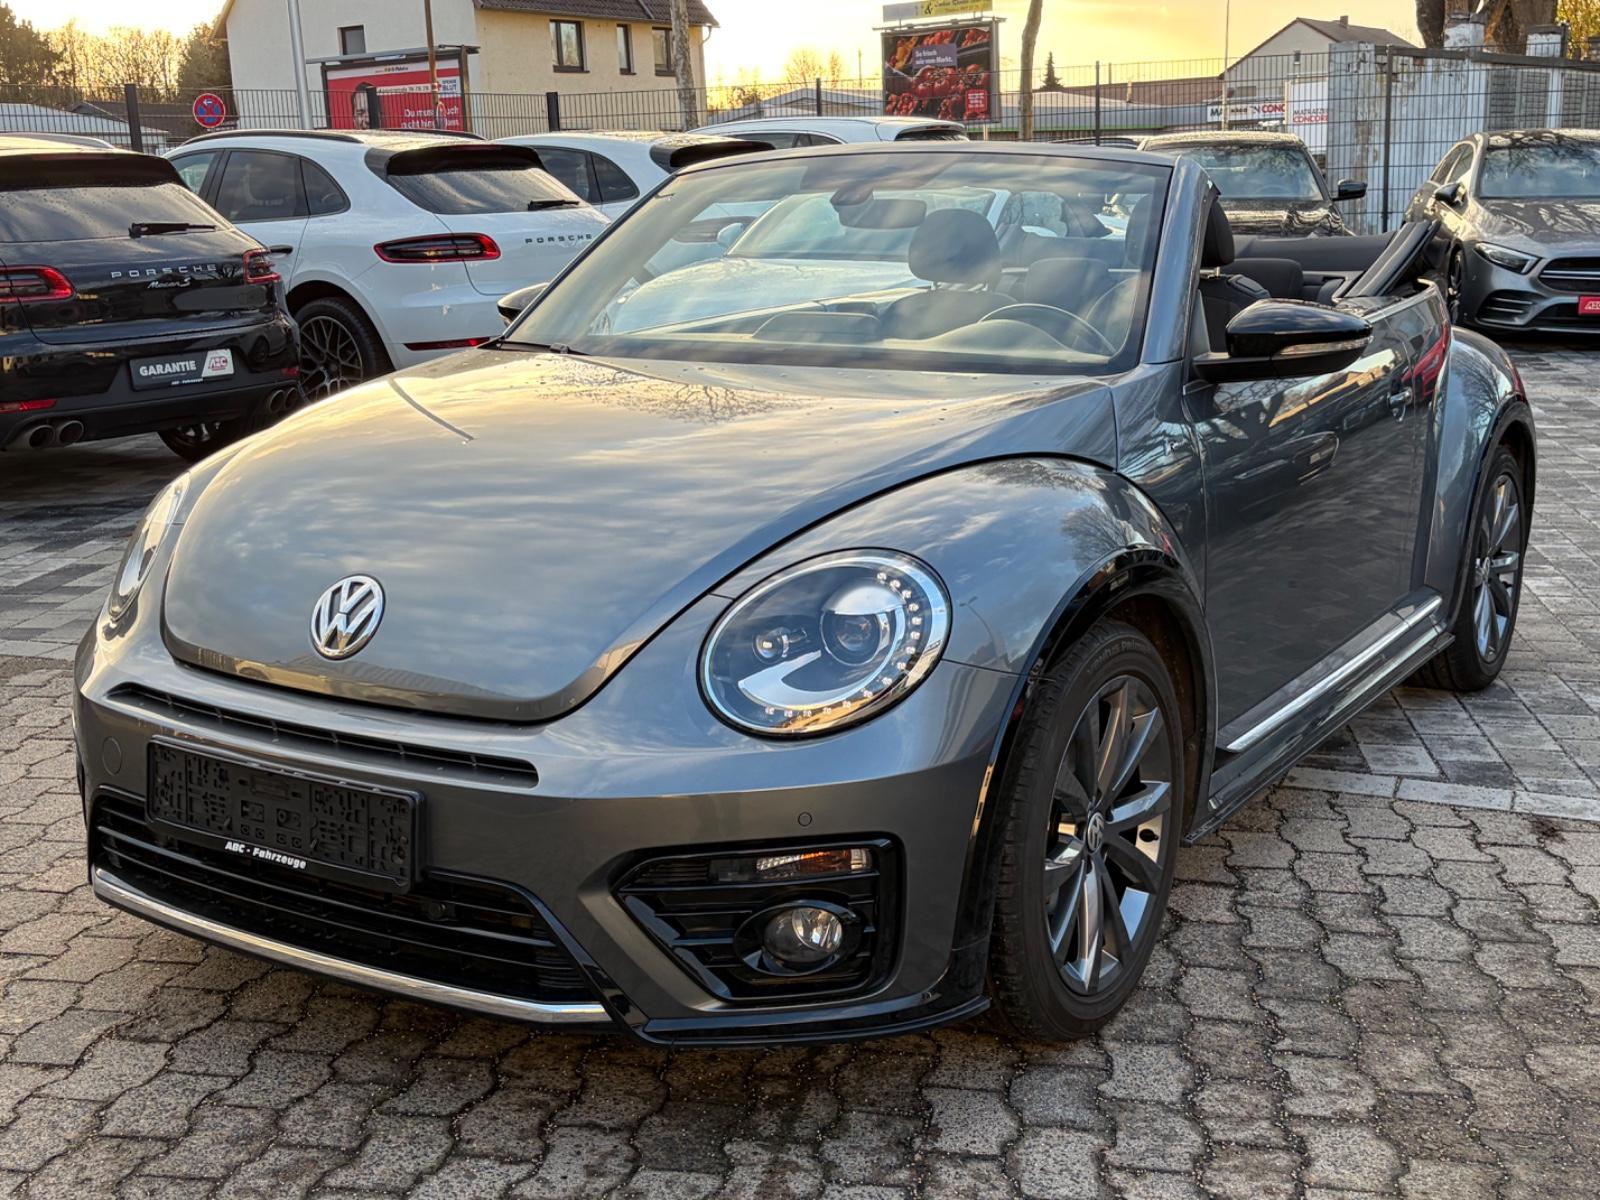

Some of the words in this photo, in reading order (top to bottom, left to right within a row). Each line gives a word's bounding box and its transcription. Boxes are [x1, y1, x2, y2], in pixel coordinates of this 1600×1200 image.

[524, 233, 592, 244] PORSCHE
[111, 263, 217, 279] PORSCHE
[139, 360, 197, 376] GARANTIE
[224, 841, 246, 854] ABC
[252, 847, 307, 869] Fahrzeuge
